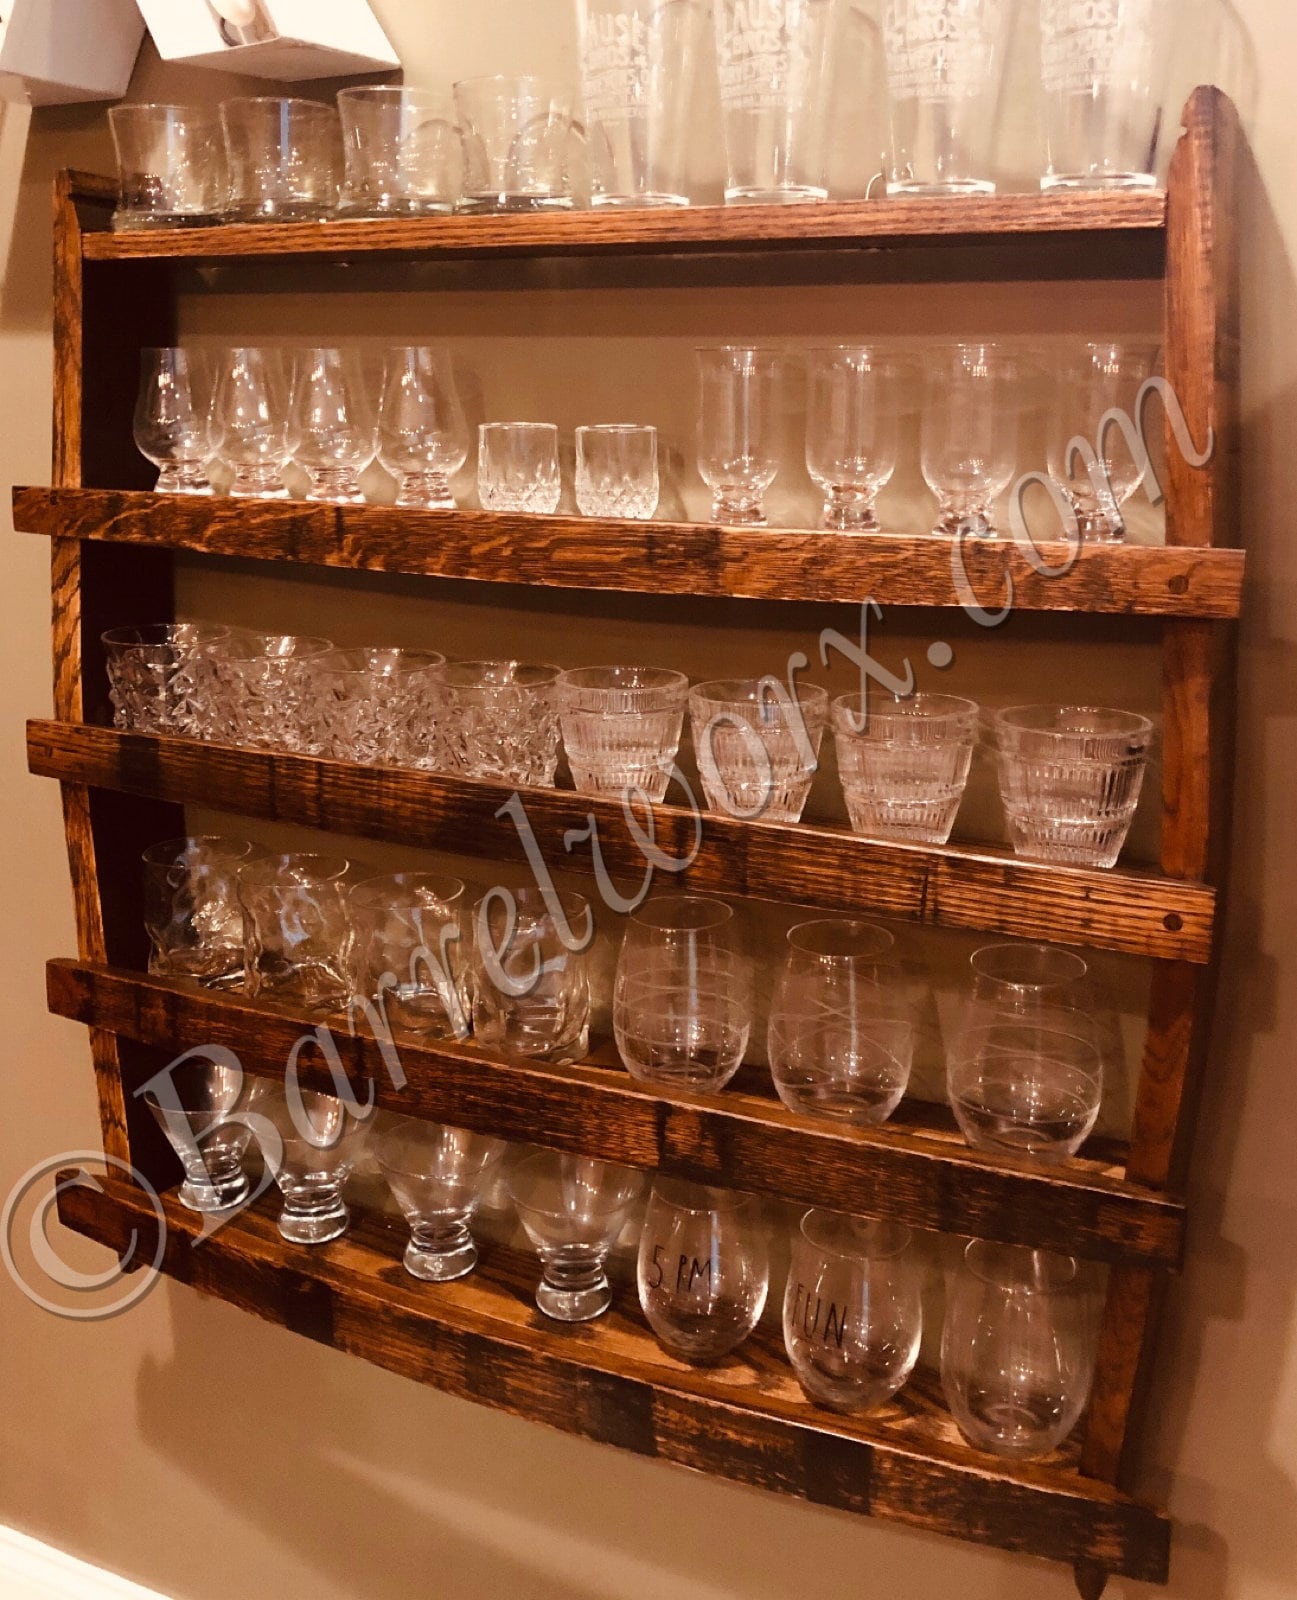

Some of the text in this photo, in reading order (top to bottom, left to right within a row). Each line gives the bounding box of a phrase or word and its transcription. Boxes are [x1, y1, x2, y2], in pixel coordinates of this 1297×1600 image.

[647, 1244, 712, 1298] 5 PM
[790, 1283, 848, 1349] FUN
